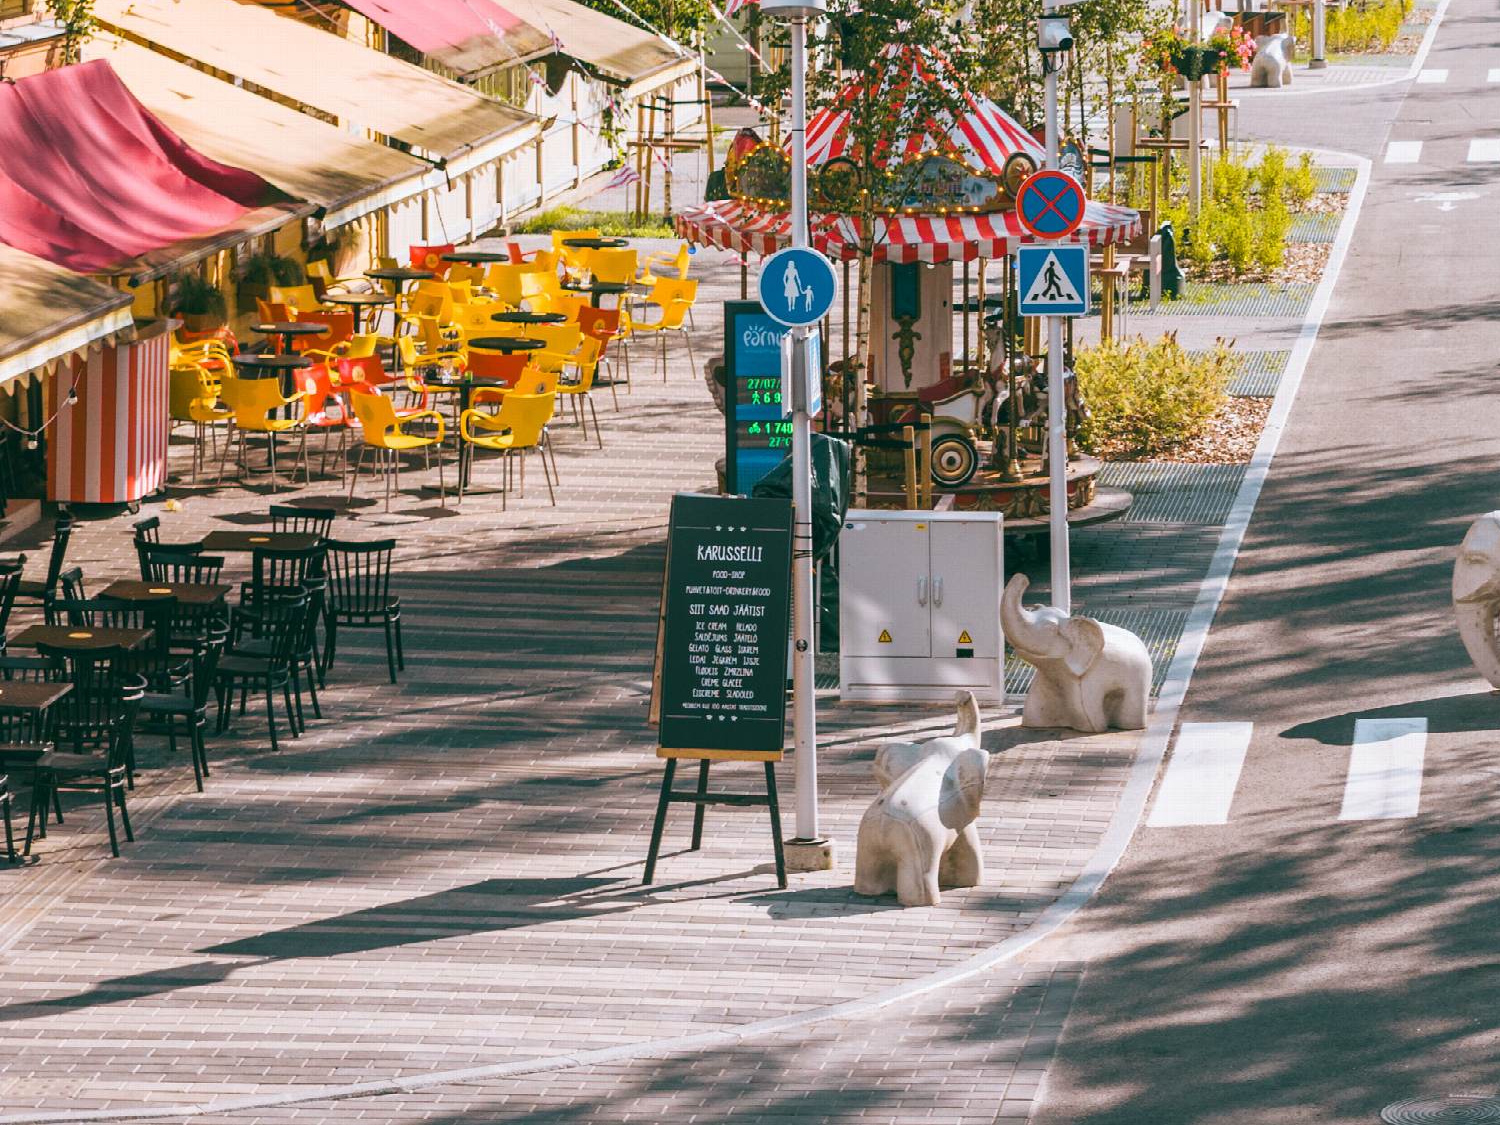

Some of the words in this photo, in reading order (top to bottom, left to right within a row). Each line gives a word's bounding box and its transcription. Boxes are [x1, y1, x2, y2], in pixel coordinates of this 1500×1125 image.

[763, 392, 771, 403] 6
[774, 422, 793, 434] 740
[697, 545, 763, 562] KARUSSELLI
[689, 604, 705, 615] SIIT
[709, 604, 730, 616] SAAD
[733, 604, 765, 617] JÄÄTIST
[707, 622, 727, 631] CREAM
[688, 643, 710, 653] GELATO
